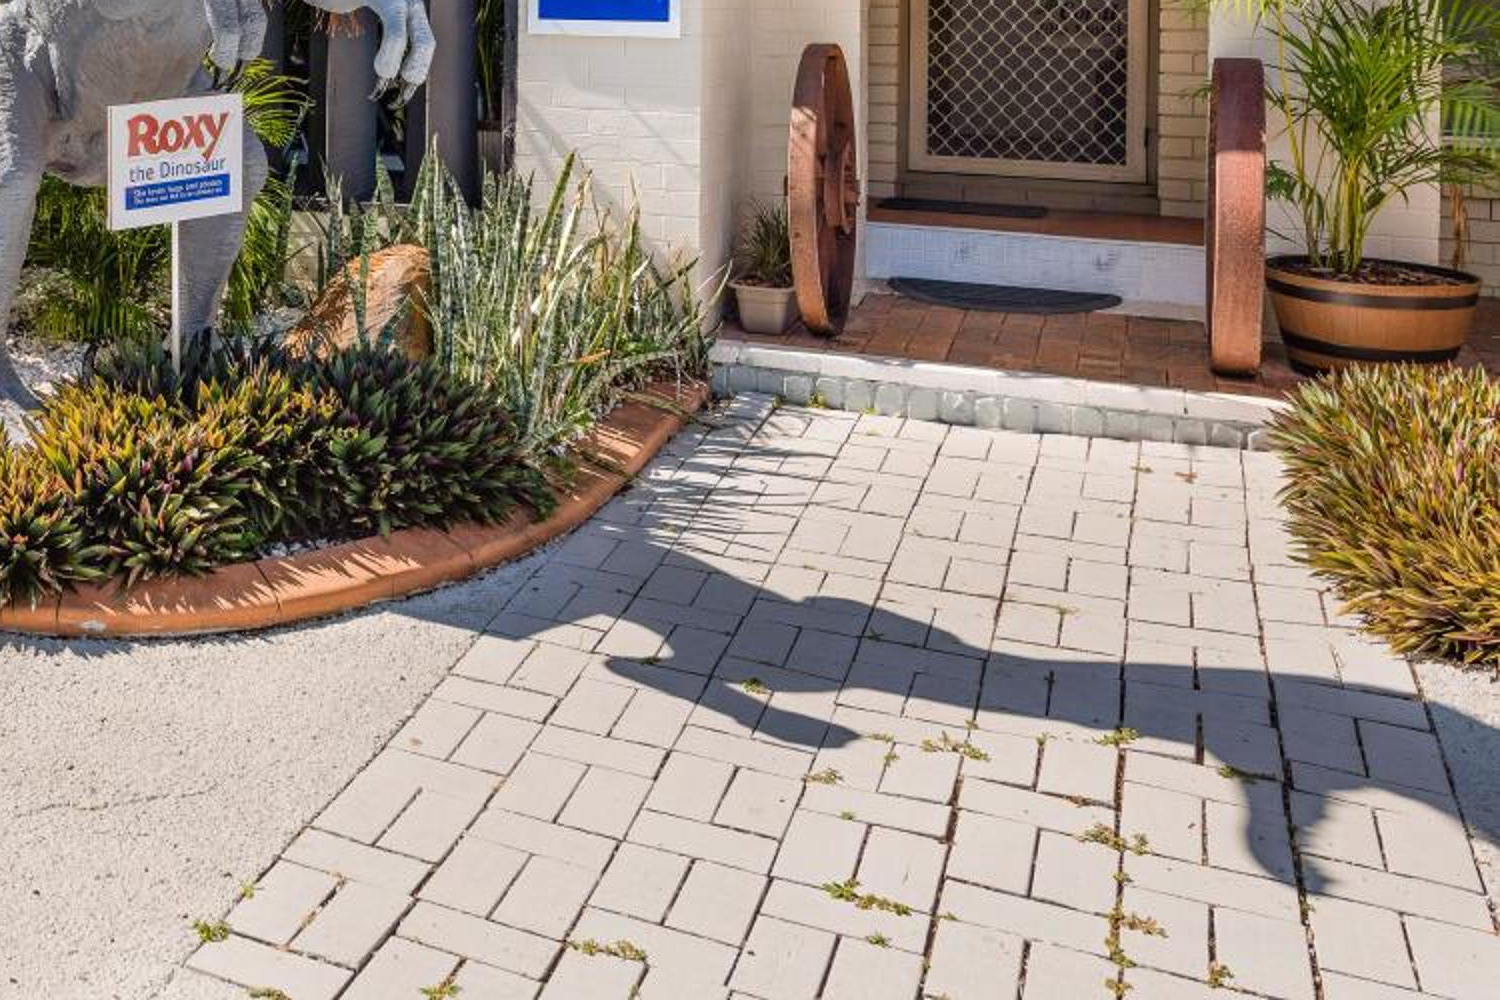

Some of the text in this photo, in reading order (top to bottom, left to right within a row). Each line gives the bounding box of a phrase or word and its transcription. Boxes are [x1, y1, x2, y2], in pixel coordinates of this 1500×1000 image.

[127, 111, 230, 161] Roxy
[129, 158, 226, 182] the Dinosaur
